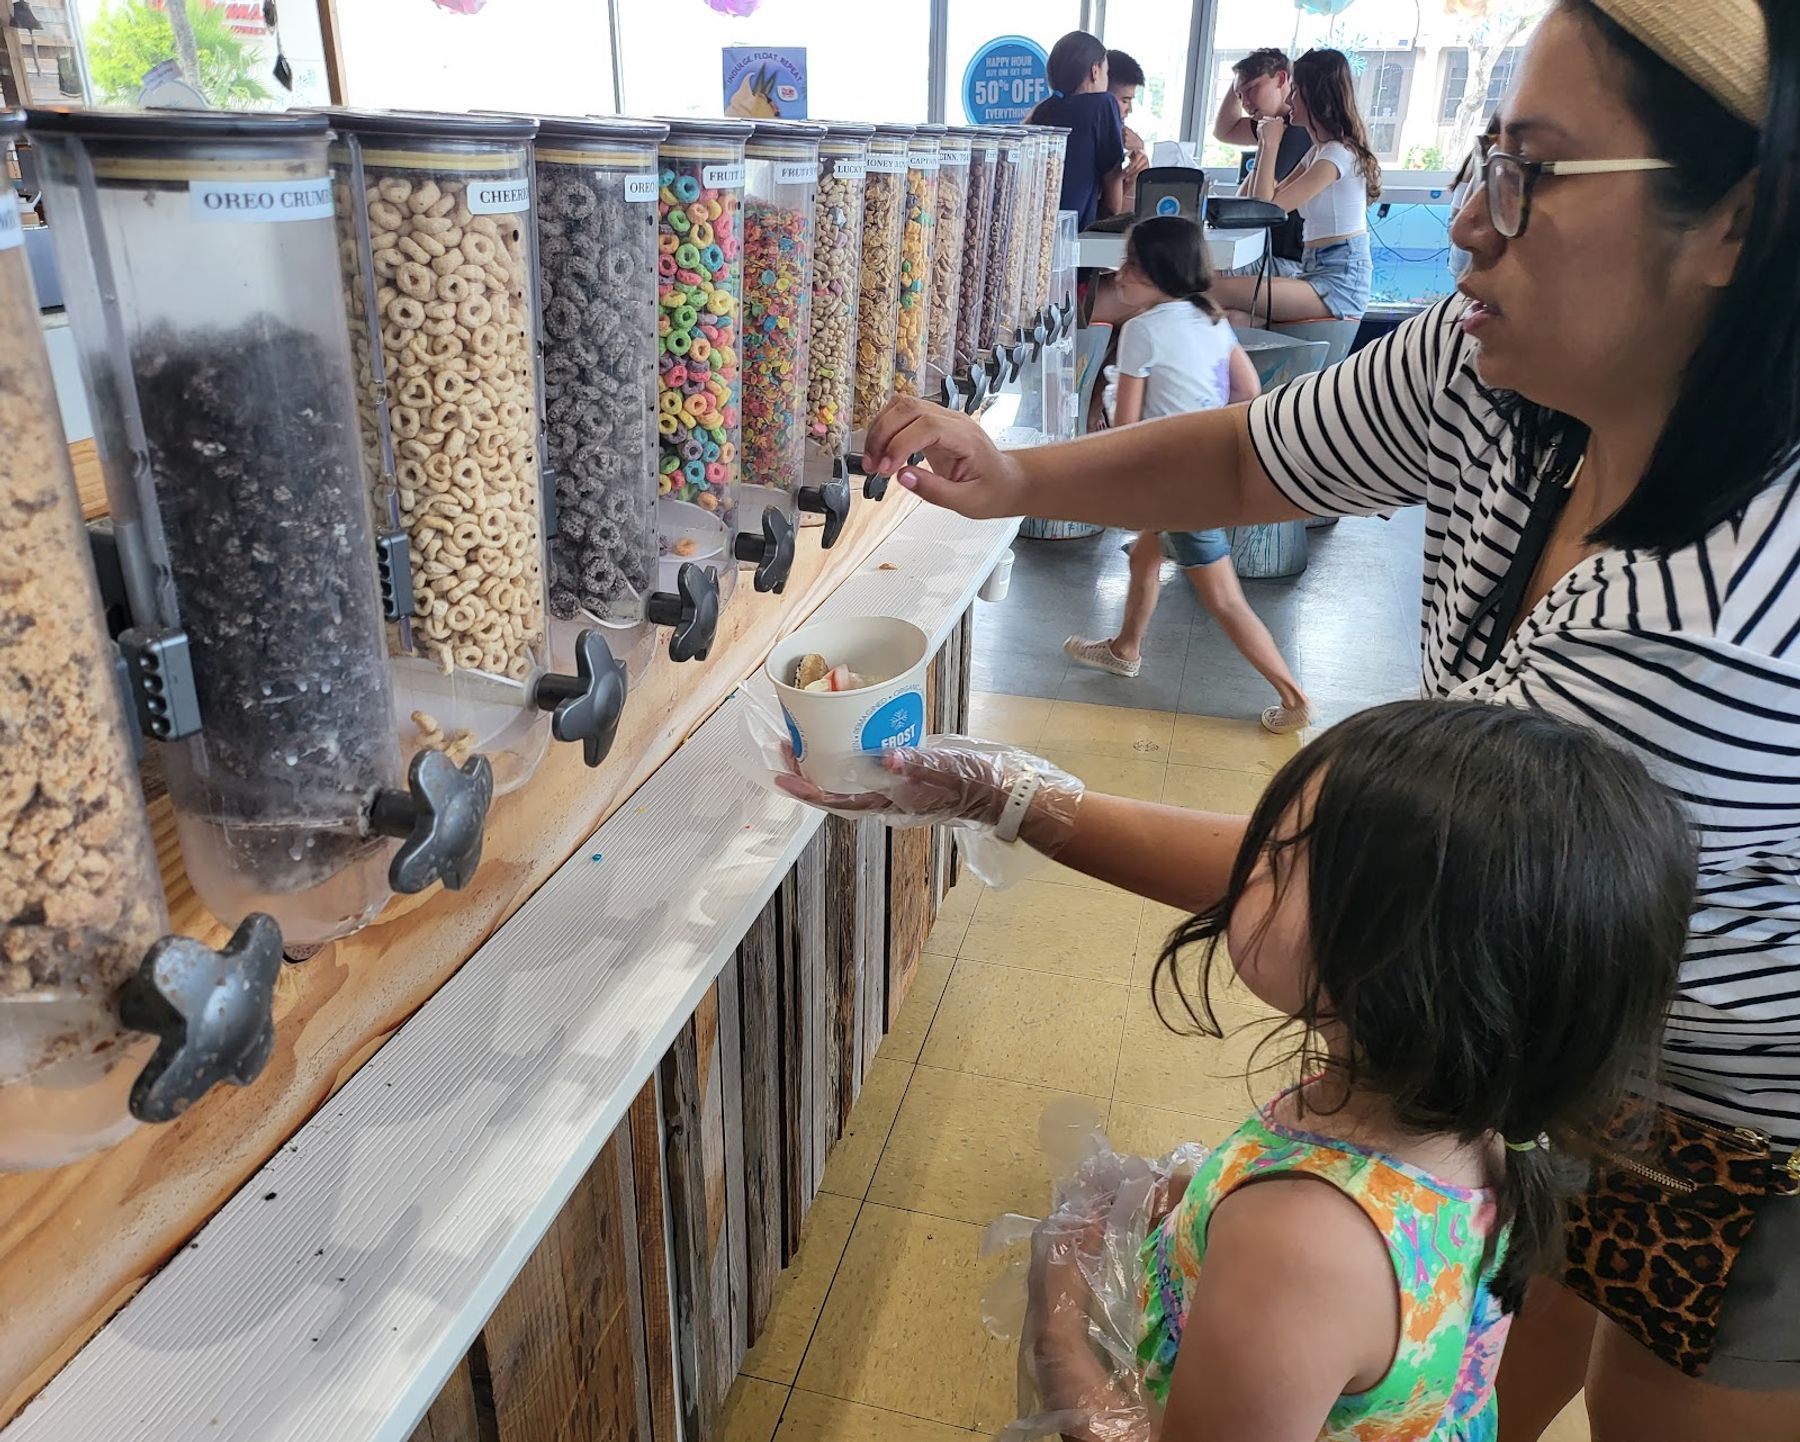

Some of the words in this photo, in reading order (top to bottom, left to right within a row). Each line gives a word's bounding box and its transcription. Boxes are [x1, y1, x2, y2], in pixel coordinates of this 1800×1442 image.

[985, 57, 1010, 67] HAPPY
[1011, 56, 1032, 66] HOUR
[780, 57, 802, 82] REPEAT
[986, 69, 997, 77] BUY
[1010, 68, 1020, 76] GET
[975, 79, 1009, 105] 50%
[1011, 78, 1045, 104] OFF
[837, 165, 862, 174] LUCKY
[709, 171, 738, 181] FRUIT
[629, 182, 654, 193] OREO
[204, 192, 274, 210] OREO
[881, 723, 915, 748] FROST
